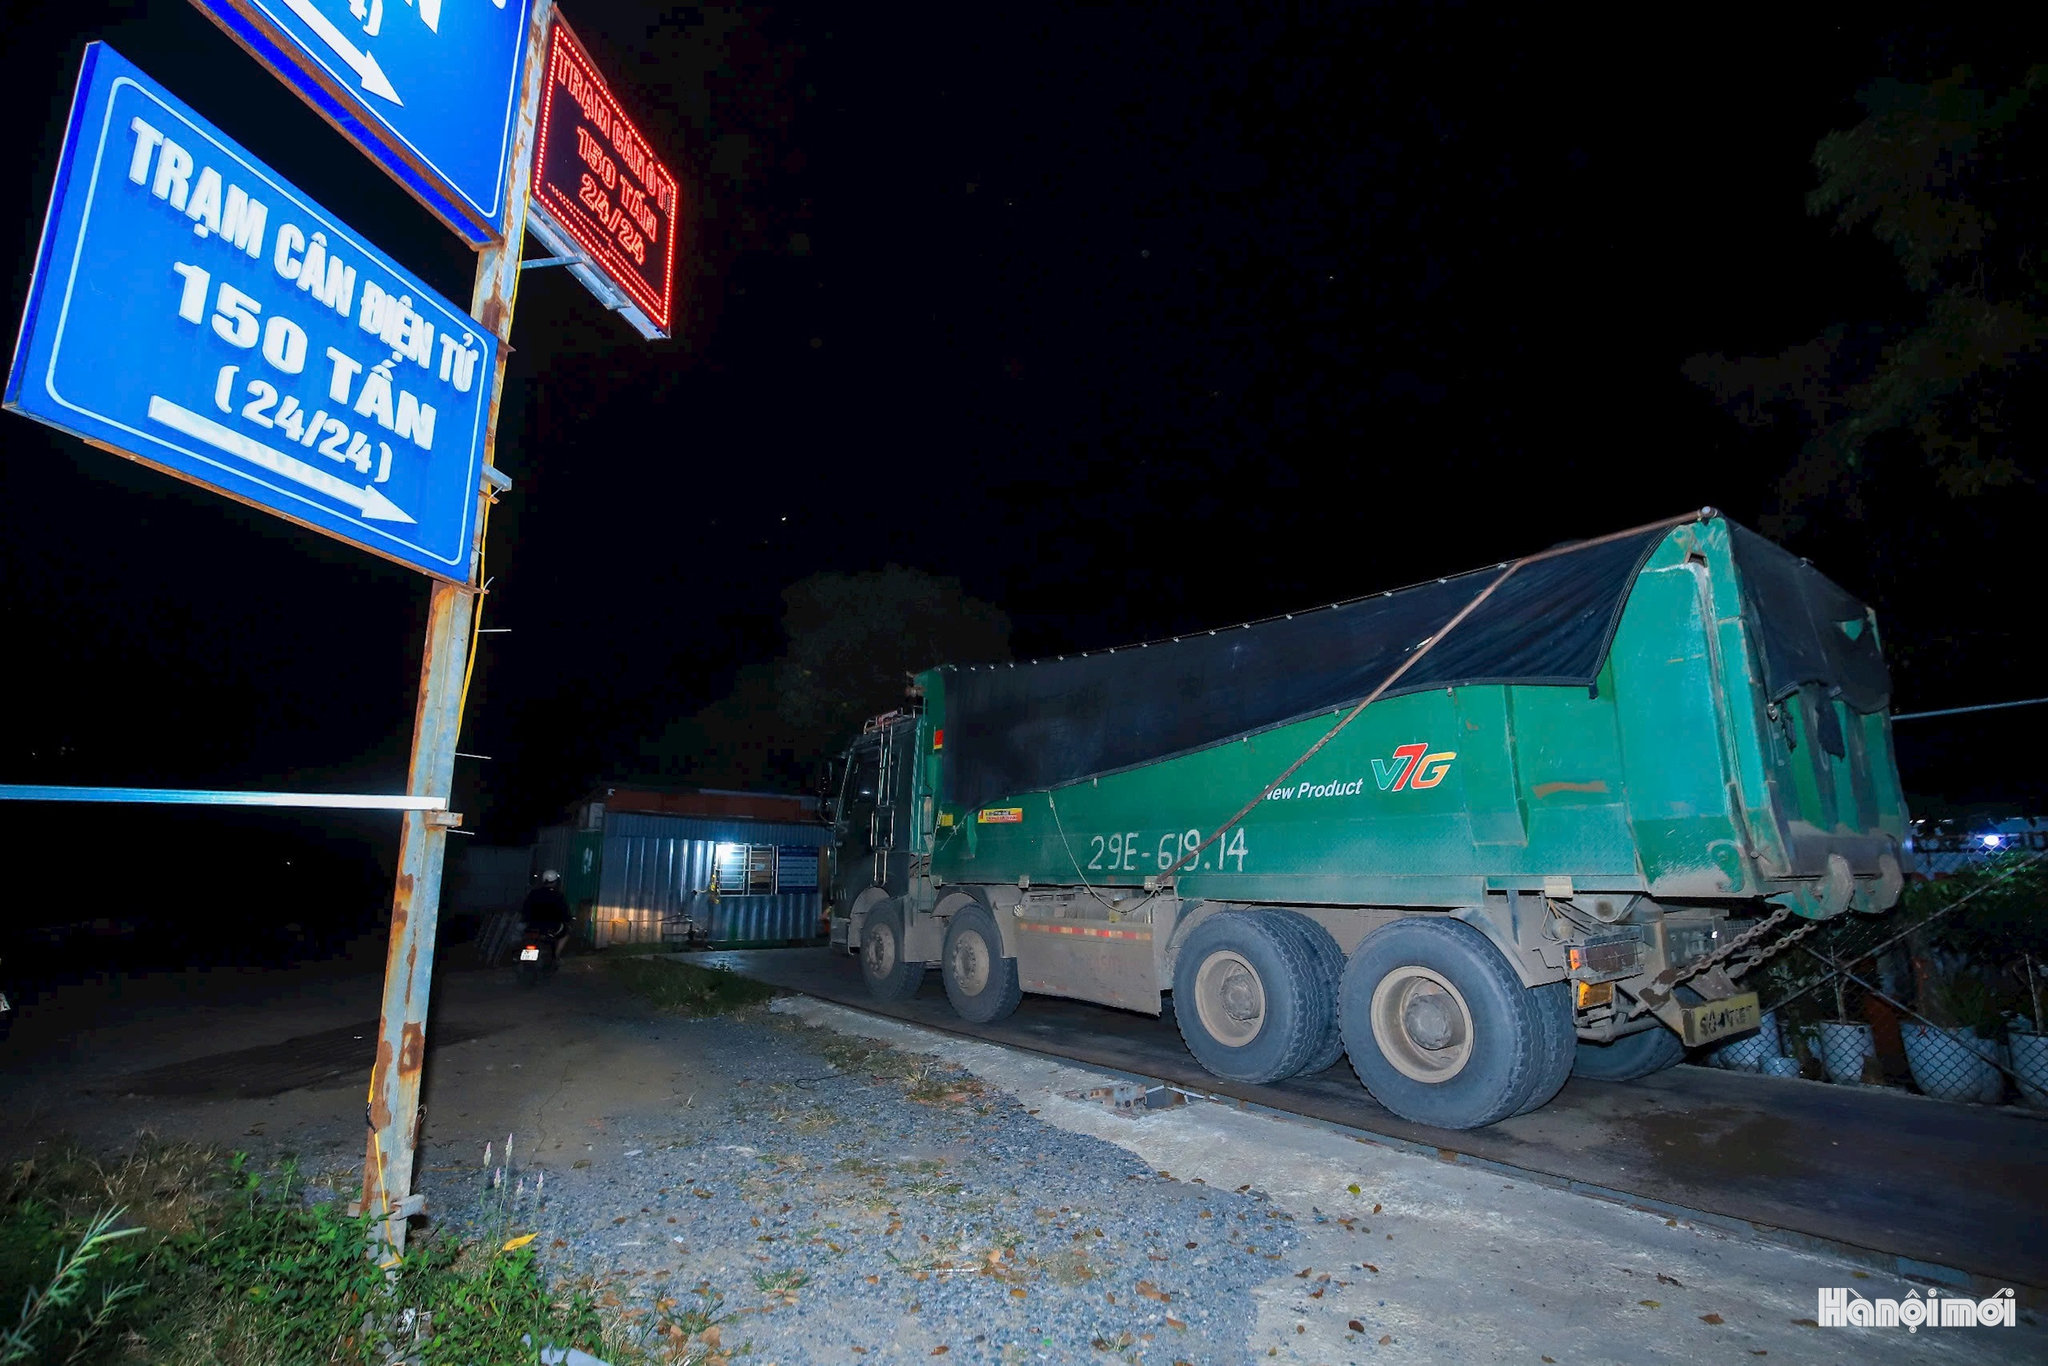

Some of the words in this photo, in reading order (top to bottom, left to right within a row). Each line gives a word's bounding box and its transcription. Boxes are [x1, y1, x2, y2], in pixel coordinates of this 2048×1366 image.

[557, 47, 611, 139] TRẠM
[577, 125, 616, 190] 150
[619, 173, 658, 243] TẤN
[579, 172, 645, 266] 24/24
[128, 116, 268, 260] TRẠM
[273, 222, 357, 318] CÂN
[358, 279, 435, 369] ĐIỆN
[439, 332, 479, 393] TỬ
[173, 261, 308, 375] 150
[326, 345, 437, 451] TẤN
[1297, 777, 1364, 798] Product
